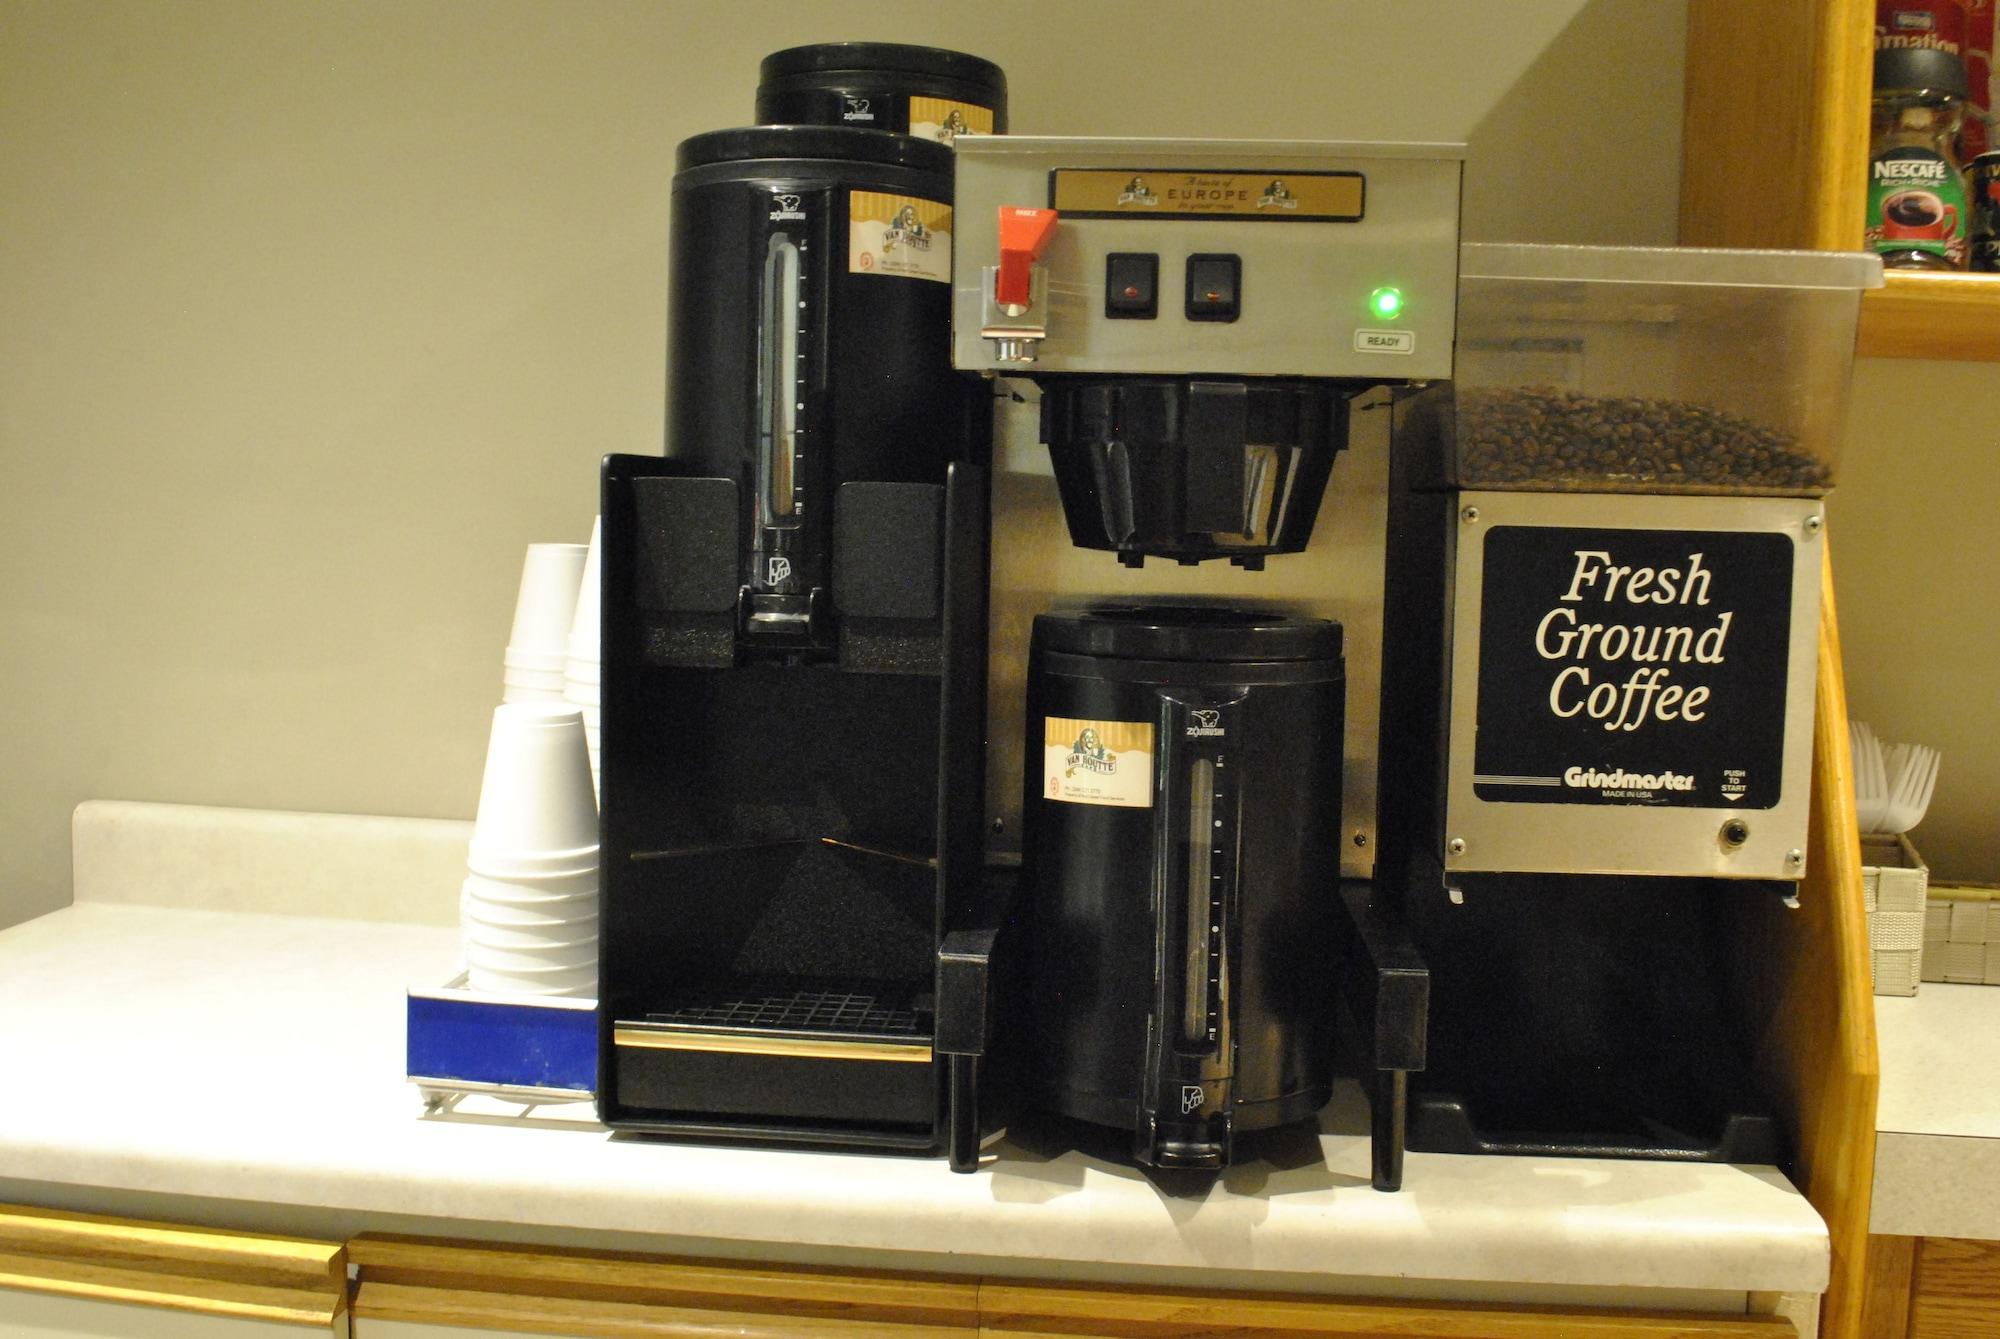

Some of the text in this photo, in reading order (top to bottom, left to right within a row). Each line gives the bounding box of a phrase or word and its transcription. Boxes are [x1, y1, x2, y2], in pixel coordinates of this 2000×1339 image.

[1874, 160, 1946, 179] NESCAFÉ
[1167, 189, 1249, 201] EUROPE
[1367, 336, 1400, 346] READY
[1560, 550, 1712, 606] Fresh
[1535, 608, 1734, 665] Ground
[1549, 666, 1710, 731] Coffee
[1067, 754, 1080, 766] VAN
[1082, 755, 1114, 772] HOUTTE
[1564, 766, 1694, 790] Grindmaster
[1723, 769, 1746, 777] PUSH
[1721, 784, 1747, 792] START
[1728, 777, 1740, 785] TO
[1602, 790, 1626, 798] MADE
[1636, 791, 1652, 799] USA
